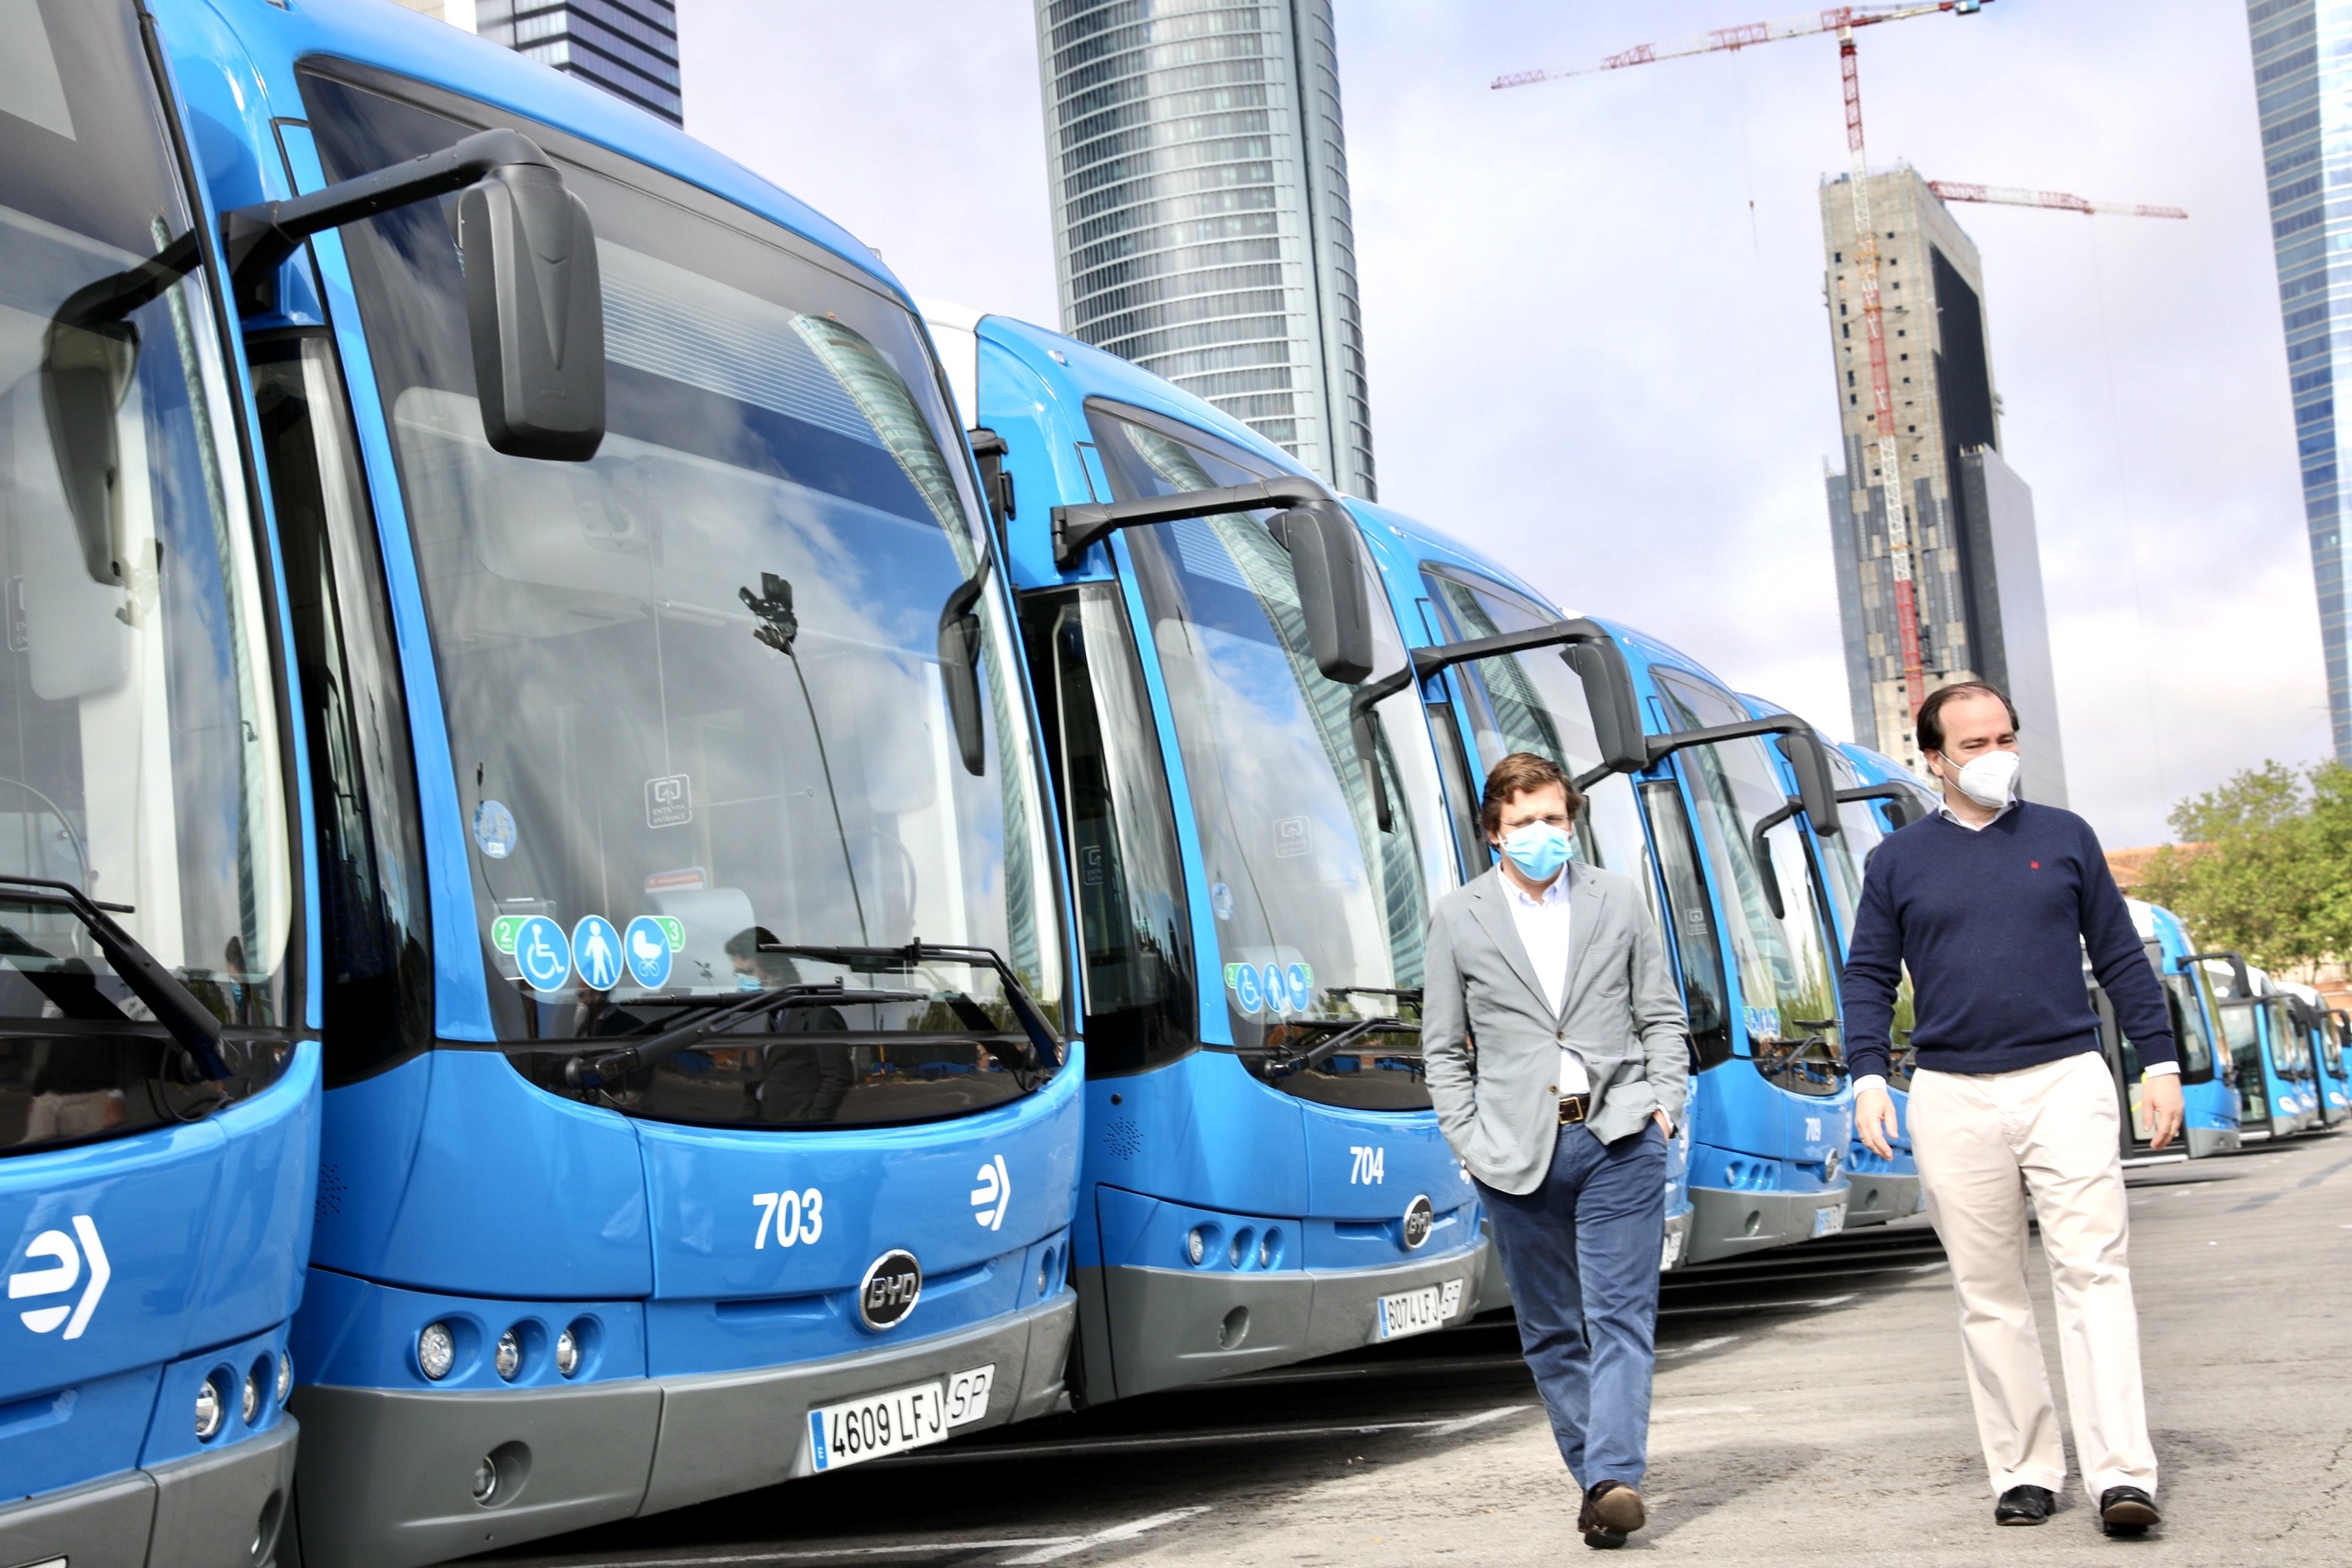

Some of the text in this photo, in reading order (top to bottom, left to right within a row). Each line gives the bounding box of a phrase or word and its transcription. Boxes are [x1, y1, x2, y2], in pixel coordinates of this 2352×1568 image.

[499, 921, 512, 942] 2
[669, 921, 679, 941] 3
[1227, 967, 1235, 981] 2
[1350, 1146, 1384, 1185] 704
[752, 1188, 823, 1250] 703
[1408, 1211, 1431, 1234] BYD
[867, 1272, 917, 1309] BYD
[1388, 1291, 1439, 1331] 6074 LFJ
[951, 1373, 986, 1419] SP
[832, 1403, 891, 1457] 4609
[897, 1390, 941, 1442] LFJ
